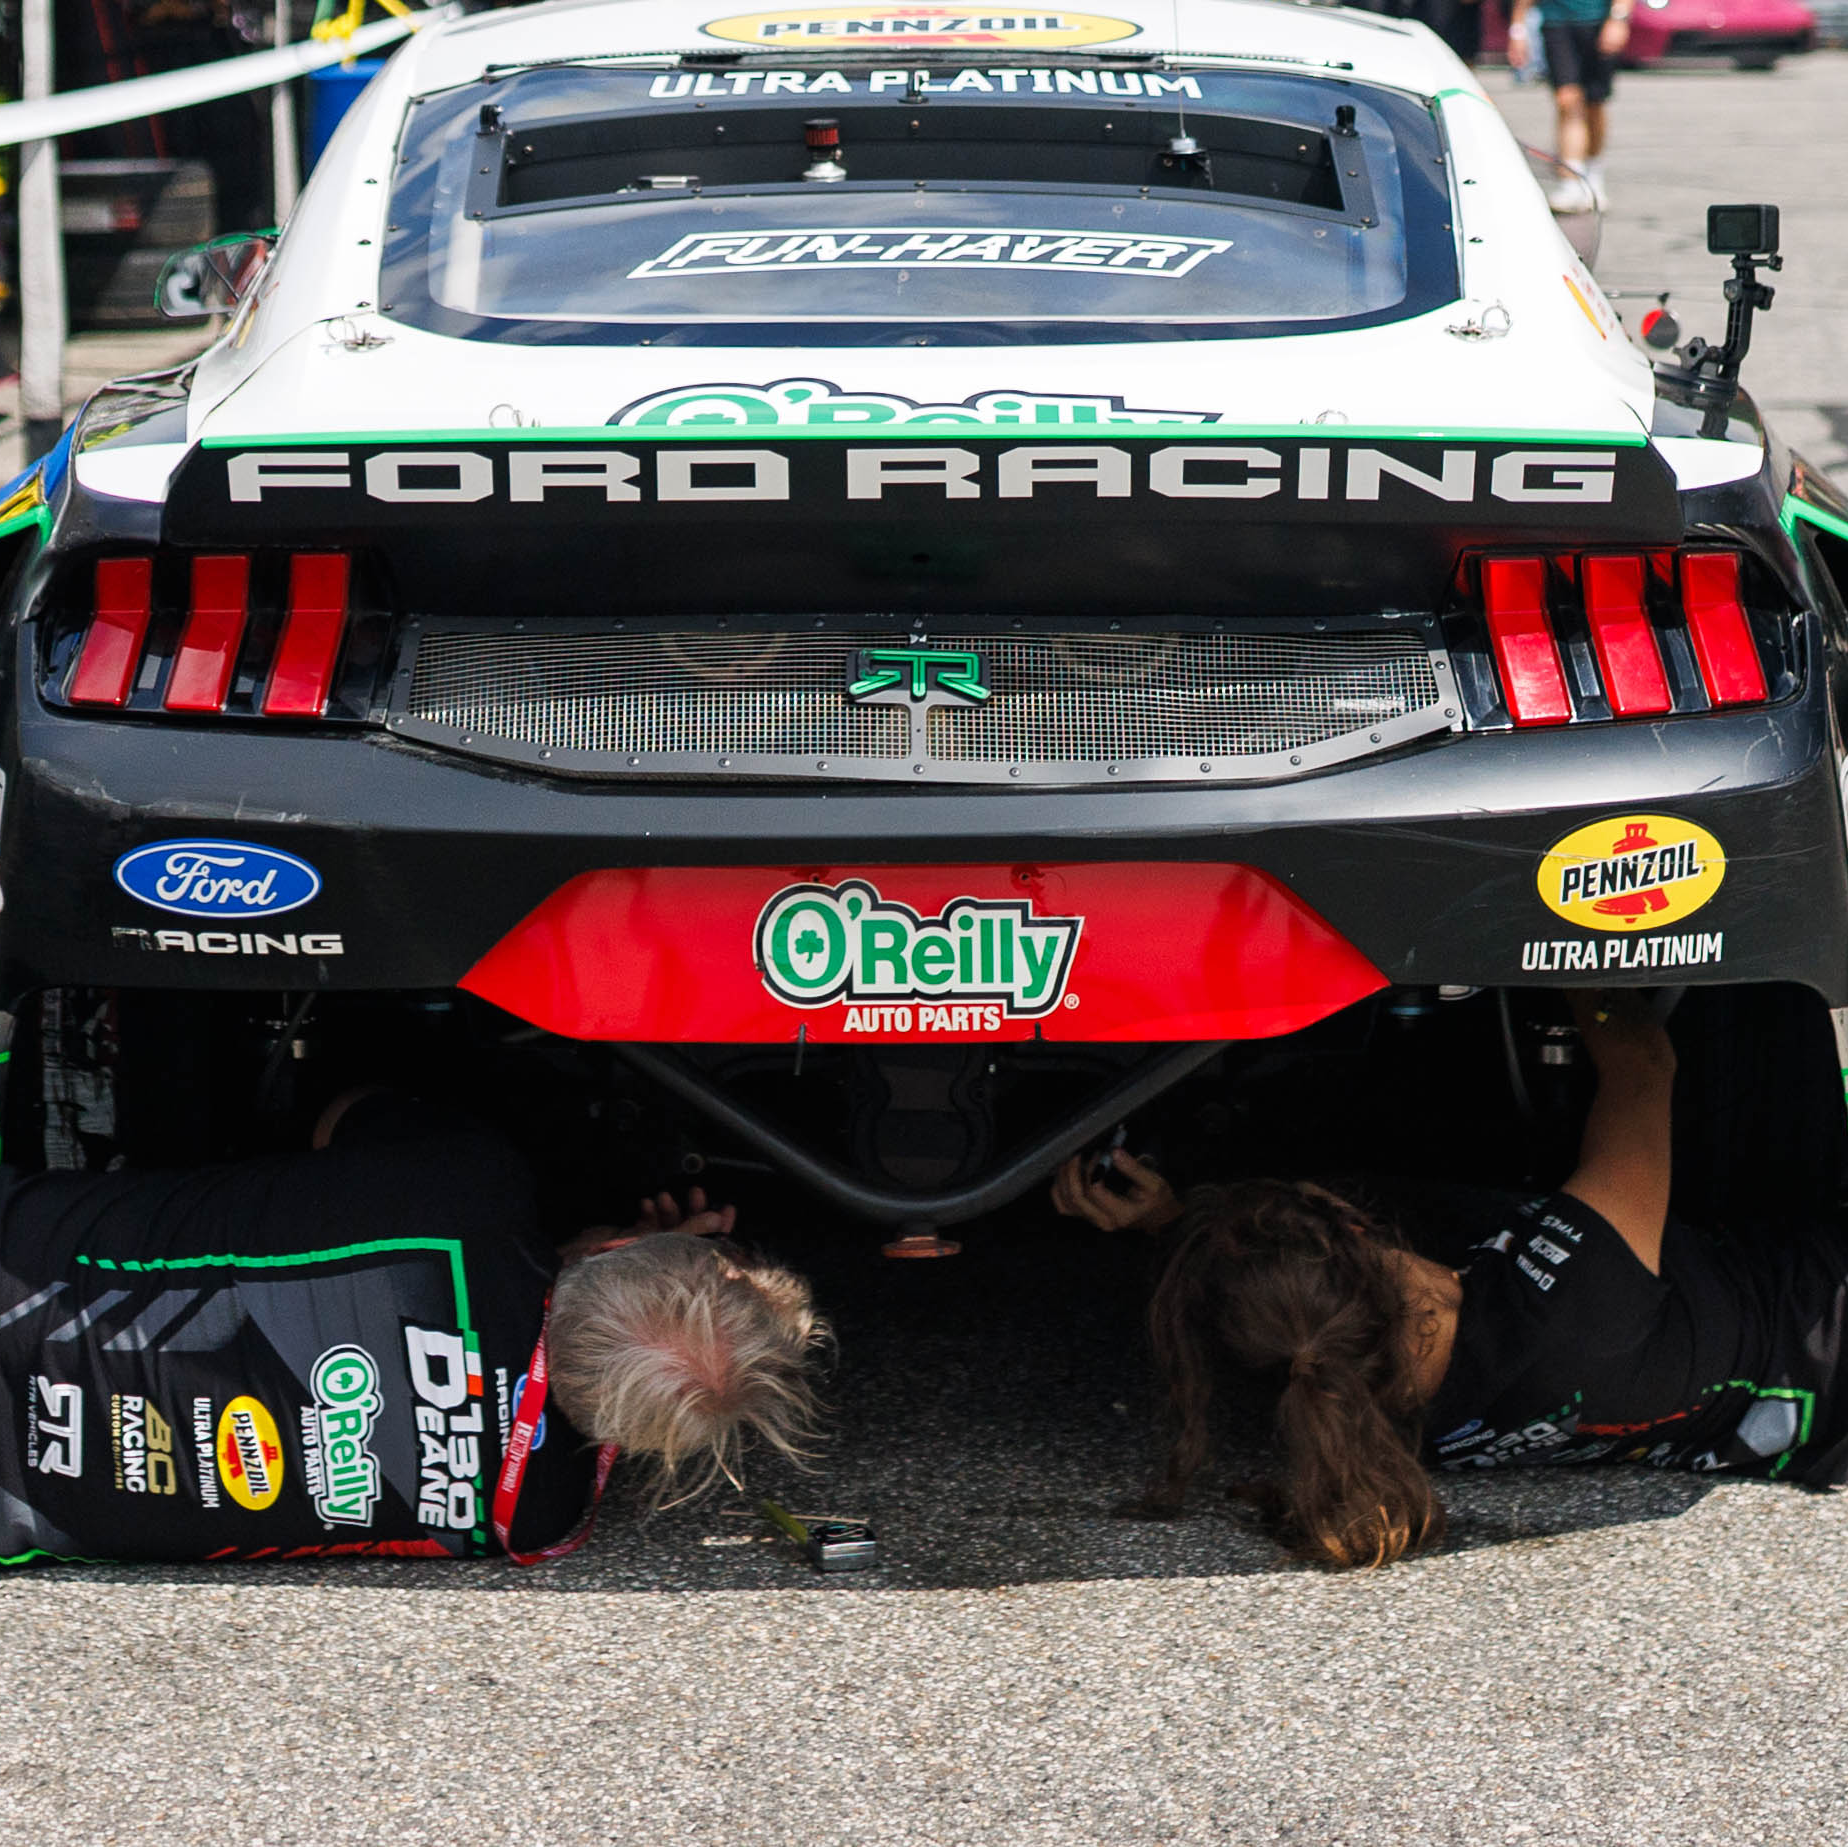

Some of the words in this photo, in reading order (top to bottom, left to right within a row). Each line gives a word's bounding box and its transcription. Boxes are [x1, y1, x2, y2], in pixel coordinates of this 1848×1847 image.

[760, 16, 1077, 37] PENNZOIL
[648, 70, 853, 99] ULTRA
[869, 67, 1204, 99] PLATINUM
[667, 234, 1190, 269] FUN-HAVER
[637, 387, 1189, 424] O'Rill
[226, 450, 790, 503] FORD
[847, 446, 1616, 504] RACING
[847, 646, 993, 701] RTR
[156, 851, 278, 906] Ford
[1559, 839, 1701, 904] PENNZOIL
[764, 895, 1071, 999] O'Reilly
[1521, 939, 1598, 971] ULTRA
[1603, 931, 1724, 970] PLATINUM
[843, 1006, 913, 1033] AUTO
[917, 1004, 1001, 1032] PARTS
[27, 1404, 39, 1468] VEHICLES
[37, 1375, 83, 1478] RTR
[111, 1393, 122, 1438] CUSTOM
[193, 1397, 212, 1442] ULTRA
[300, 1406, 319, 1447] AUTO
[321, 1358, 374, 1517] O'Reilly
[405, 1325, 468, 1528] DEANE
[122, 1394, 148, 1494] RACING
[145, 1398, 177, 1496] BC
[230, 1410, 271, 1498] PENNZOIL
[447, 1404, 484, 1530] 130
[196, 1443, 220, 1508] PLATINUM
[304, 1449, 323, 1496] PARTS
